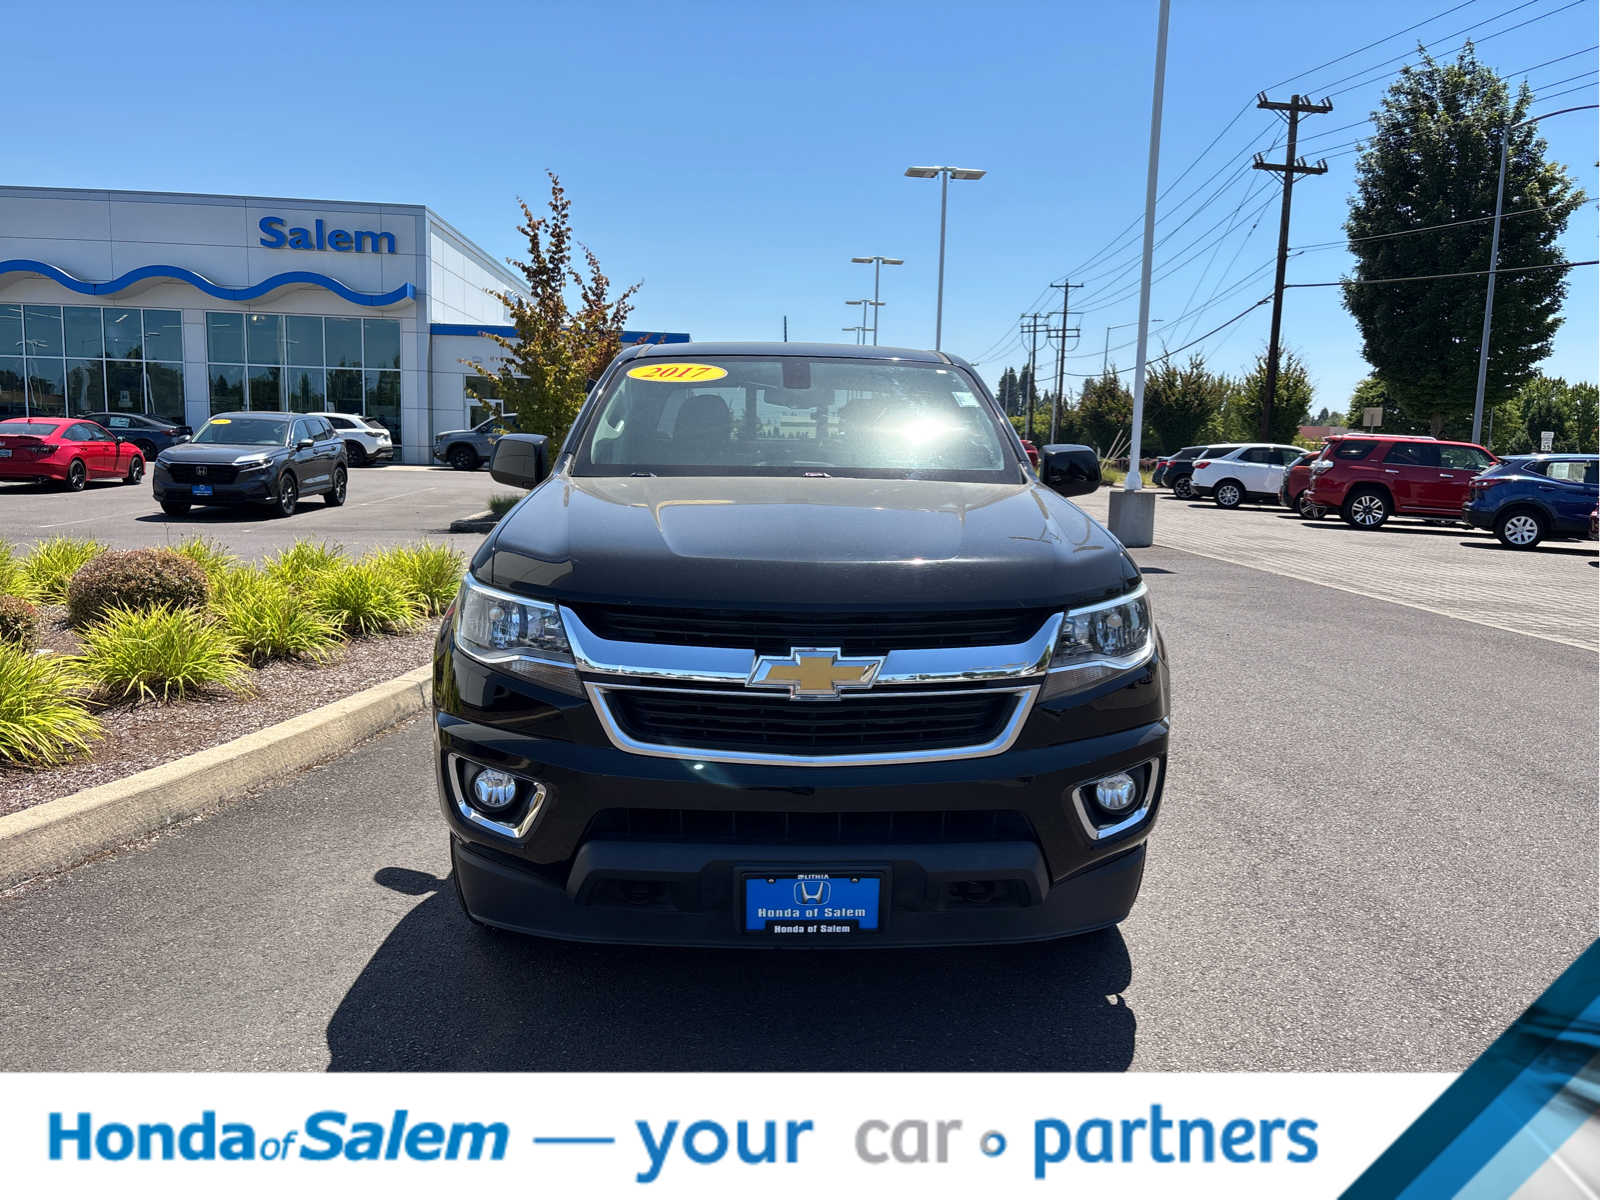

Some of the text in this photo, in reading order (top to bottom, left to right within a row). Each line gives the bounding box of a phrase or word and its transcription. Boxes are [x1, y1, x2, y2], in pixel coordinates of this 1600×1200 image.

[259, 216, 396, 253] Salem
[641, 367, 712, 378] 2017
[758, 908, 866, 918] Honda of Salem
[774, 925, 850, 934] Honda of Salem
